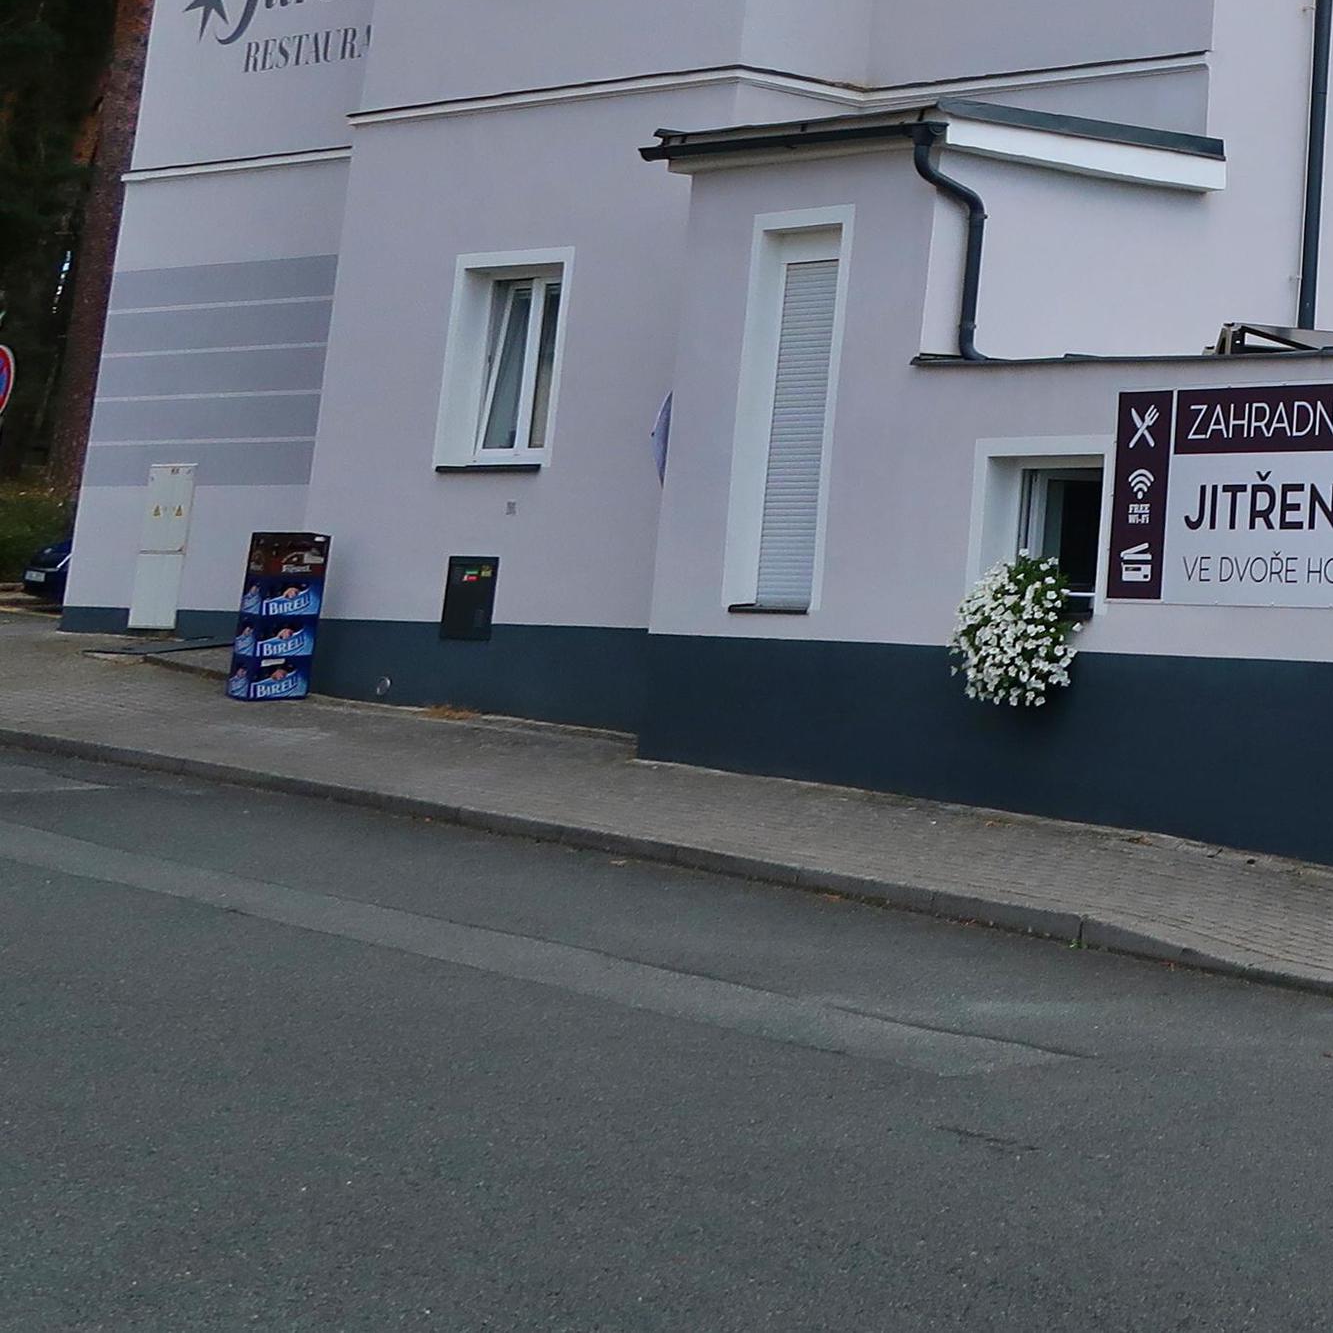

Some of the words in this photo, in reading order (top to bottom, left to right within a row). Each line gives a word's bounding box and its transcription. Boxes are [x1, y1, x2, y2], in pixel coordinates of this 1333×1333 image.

[1128, 503, 1151, 514] FREE
[1183, 555, 1212, 583] VE
[1219, 550, 1299, 584] DVOŘE
